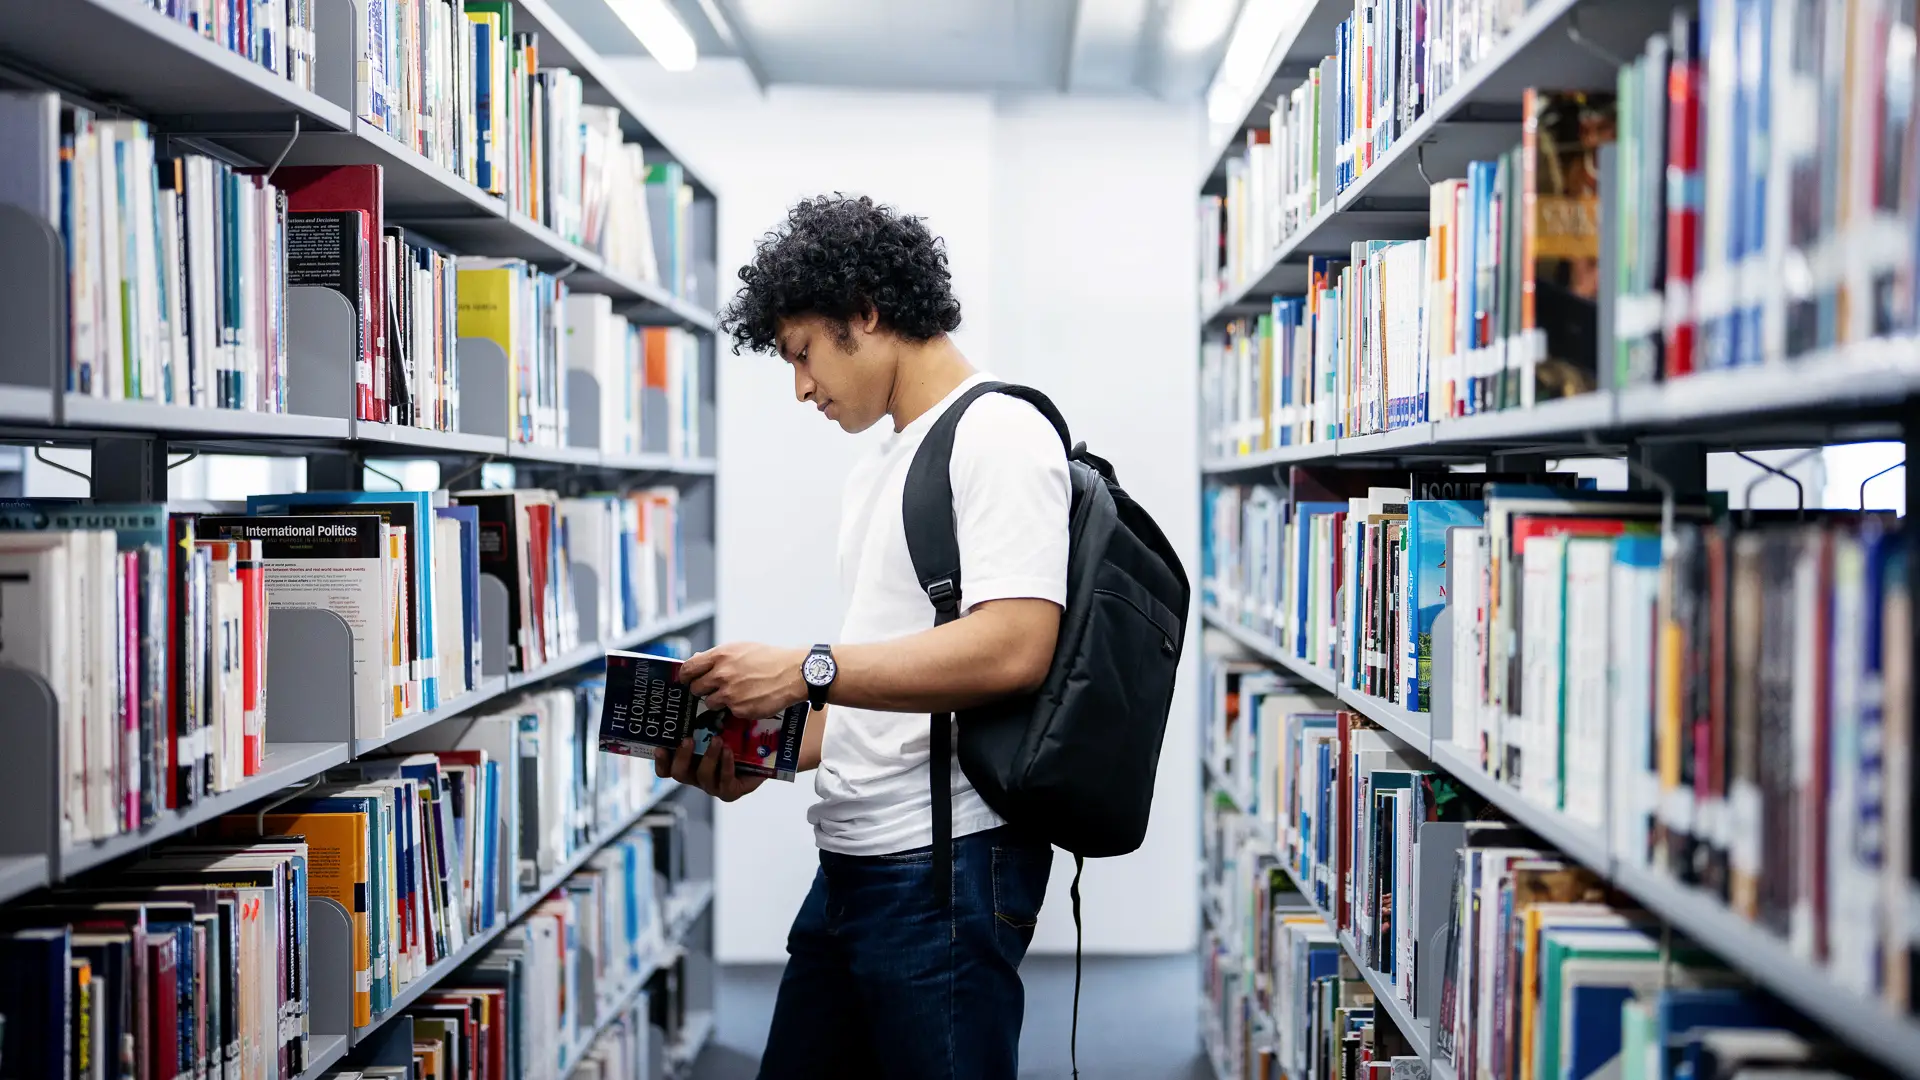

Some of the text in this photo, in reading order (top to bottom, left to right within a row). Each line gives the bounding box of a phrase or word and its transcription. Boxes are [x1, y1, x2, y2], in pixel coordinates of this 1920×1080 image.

[56, 517, 156, 527] STUDIES
[246, 525, 357, 537] International Politics
[628, 660, 649, 734] GLOBALIZATION
[646, 679, 666, 737] OF WORLD
[611, 703, 627, 730] THE
[662, 688, 682, 740] POLITICS
[783, 736, 794, 762] JOHN
